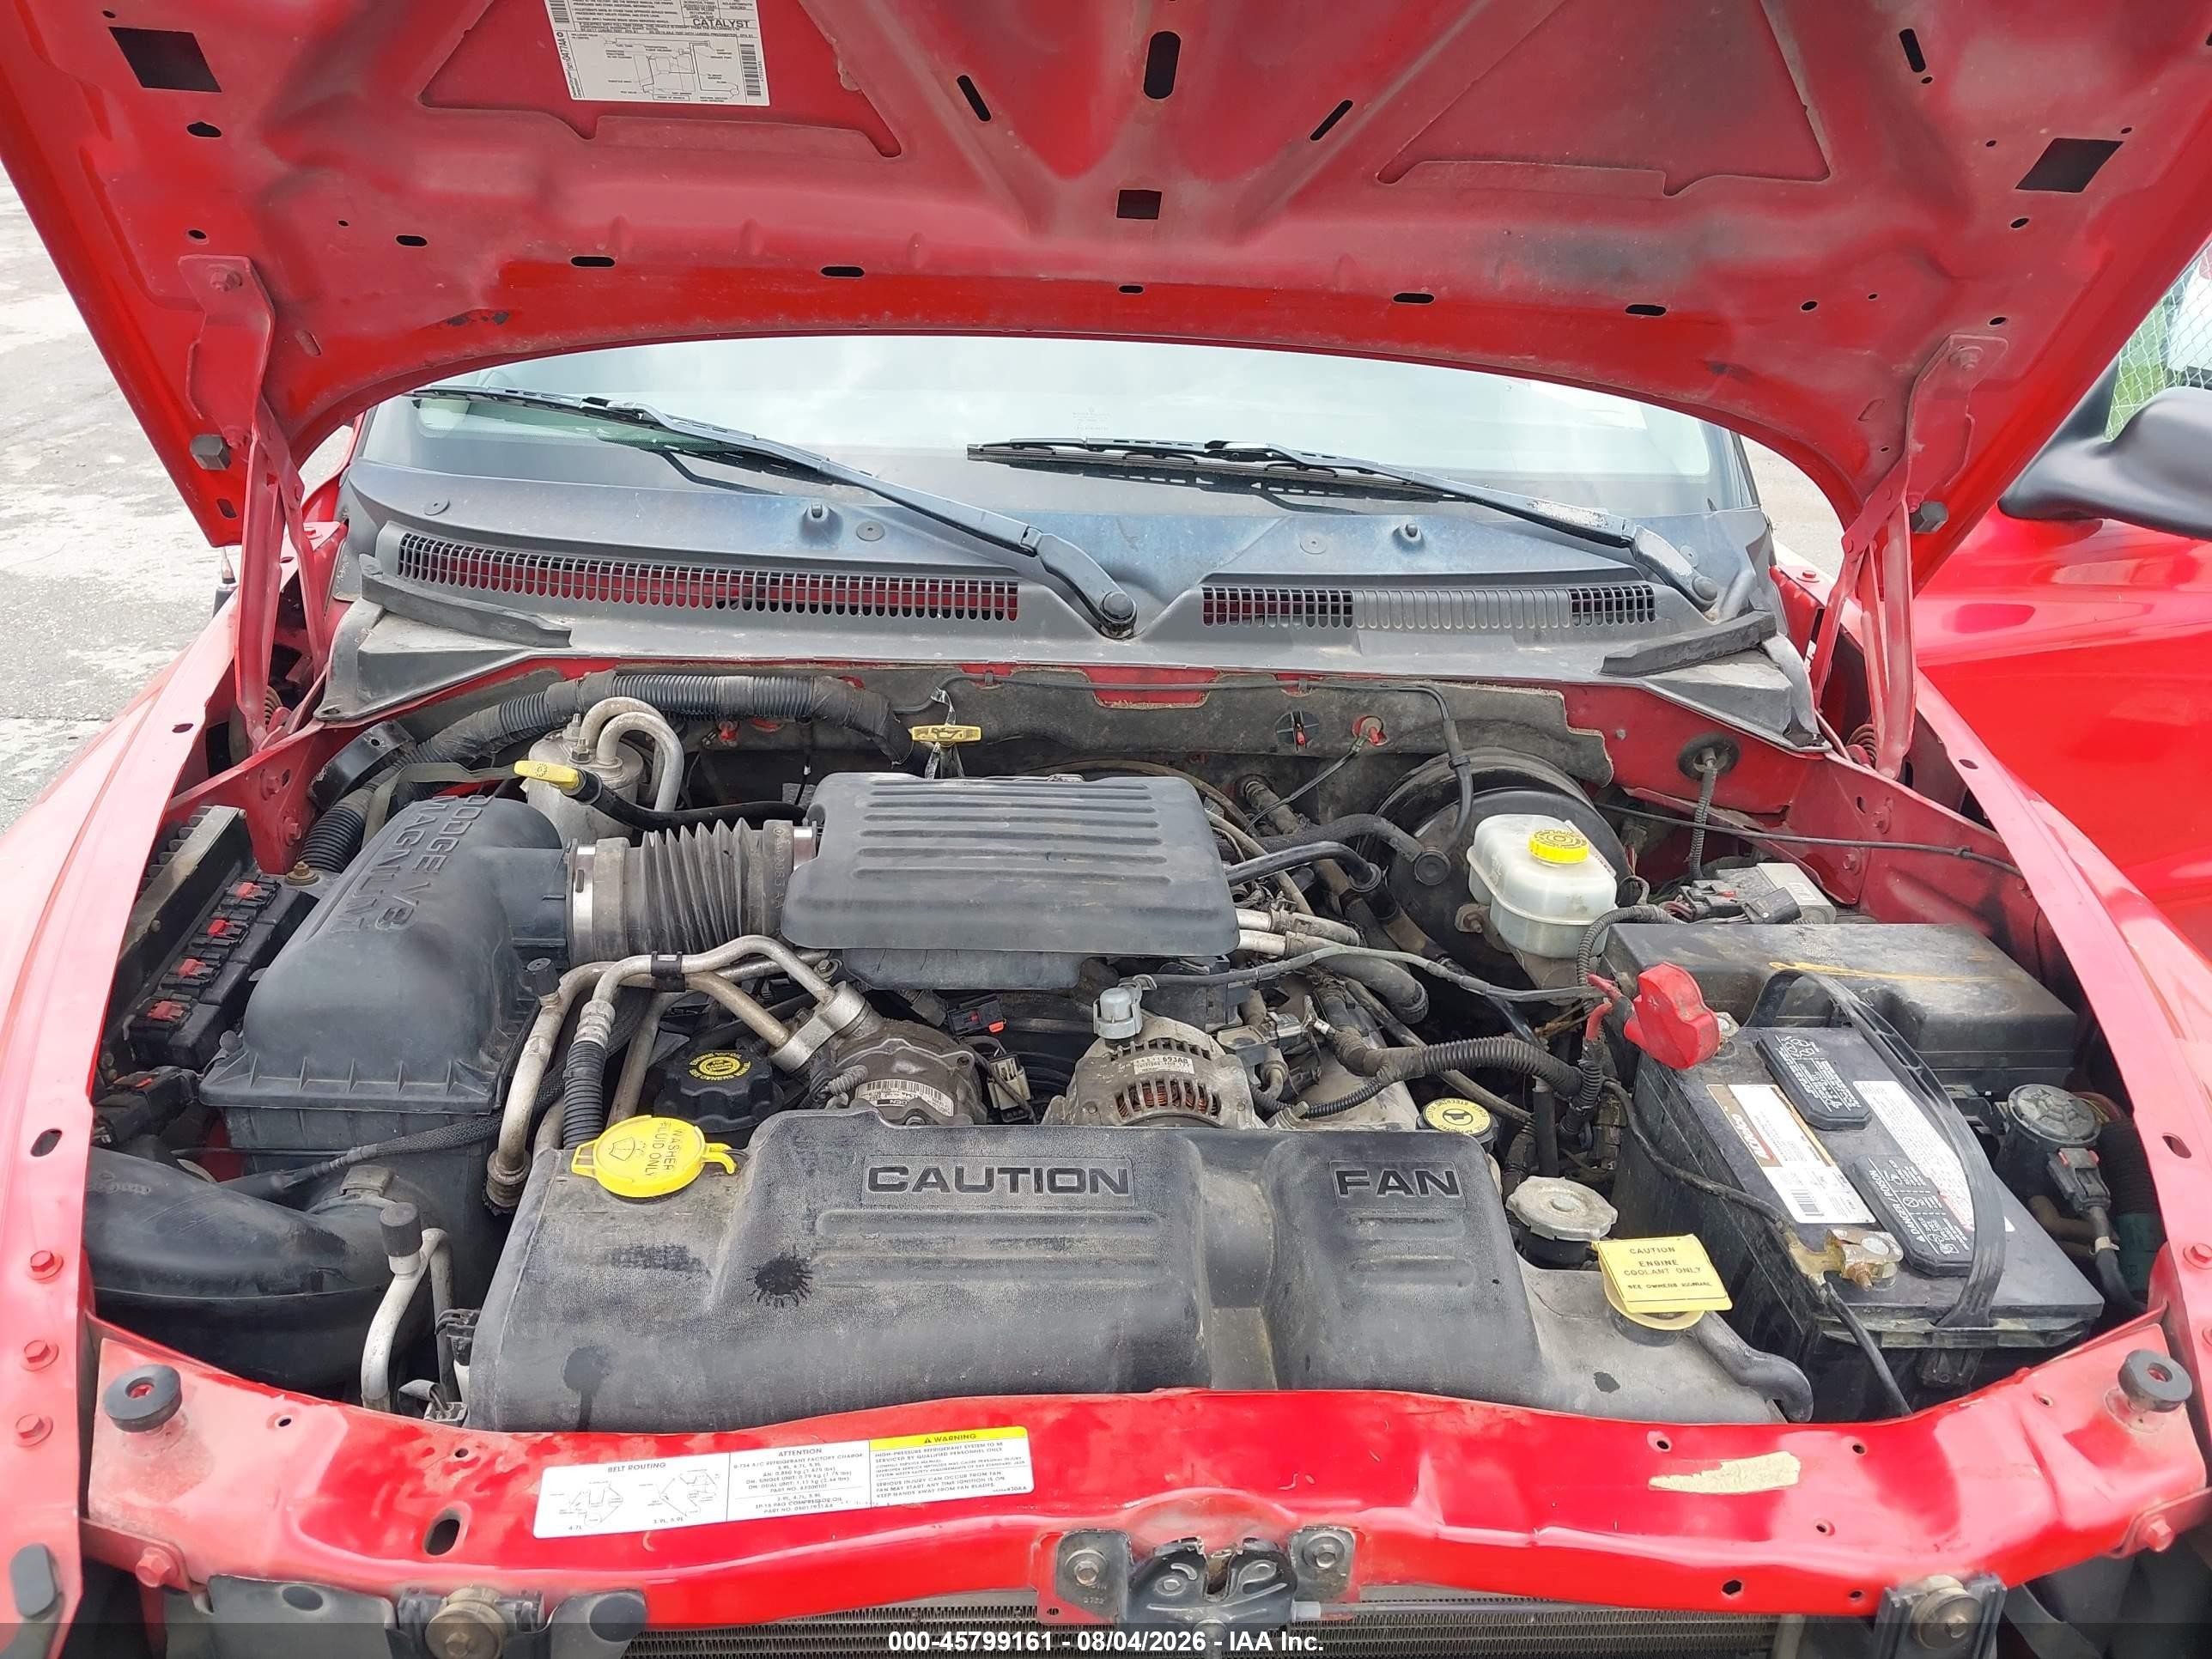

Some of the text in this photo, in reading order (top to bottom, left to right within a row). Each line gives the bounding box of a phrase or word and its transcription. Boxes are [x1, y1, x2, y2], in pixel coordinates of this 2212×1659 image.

[693, 18, 750, 28] CATALYST
[412, 794, 495, 874] DODGE
[329, 795, 459, 933] MAGNUM
[645, 1151, 663, 1176] ONLY
[663, 1130, 684, 1171] WASHER
[868, 1164, 1461, 1197] CAUTION FAN
[1869, 1170, 1893, 1197] POISON
[1893, 1203, 1918, 1236] DANGER
[1624, 1267, 1669, 1276] COOLANT
[934, 1434, 976, 1443] WARNING
[778, 1448, 823, 1456] ATTENTION
[607, 1462, 666, 1474] BELT ROUTING
